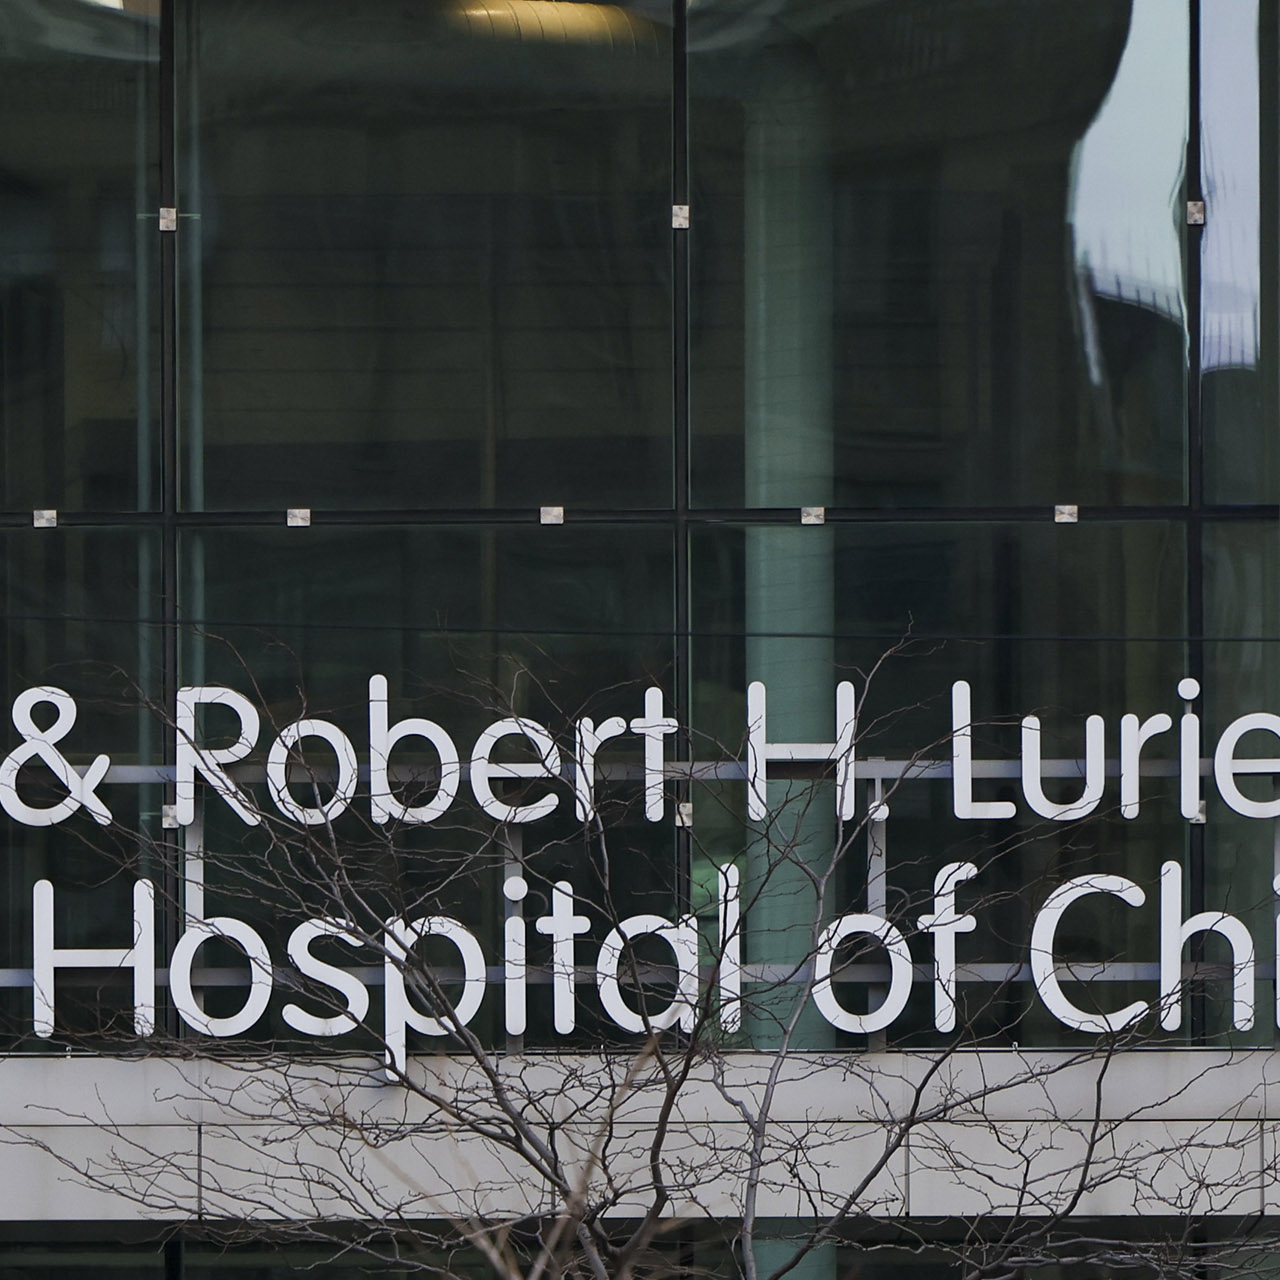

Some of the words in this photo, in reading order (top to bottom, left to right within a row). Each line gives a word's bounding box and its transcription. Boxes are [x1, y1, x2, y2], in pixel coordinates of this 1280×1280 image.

[176, 674, 678, 826] Robert
[747, 680, 891, 822] H.
[32, 861, 740, 1082] Hospital
[813, 861, 979, 1034] of
